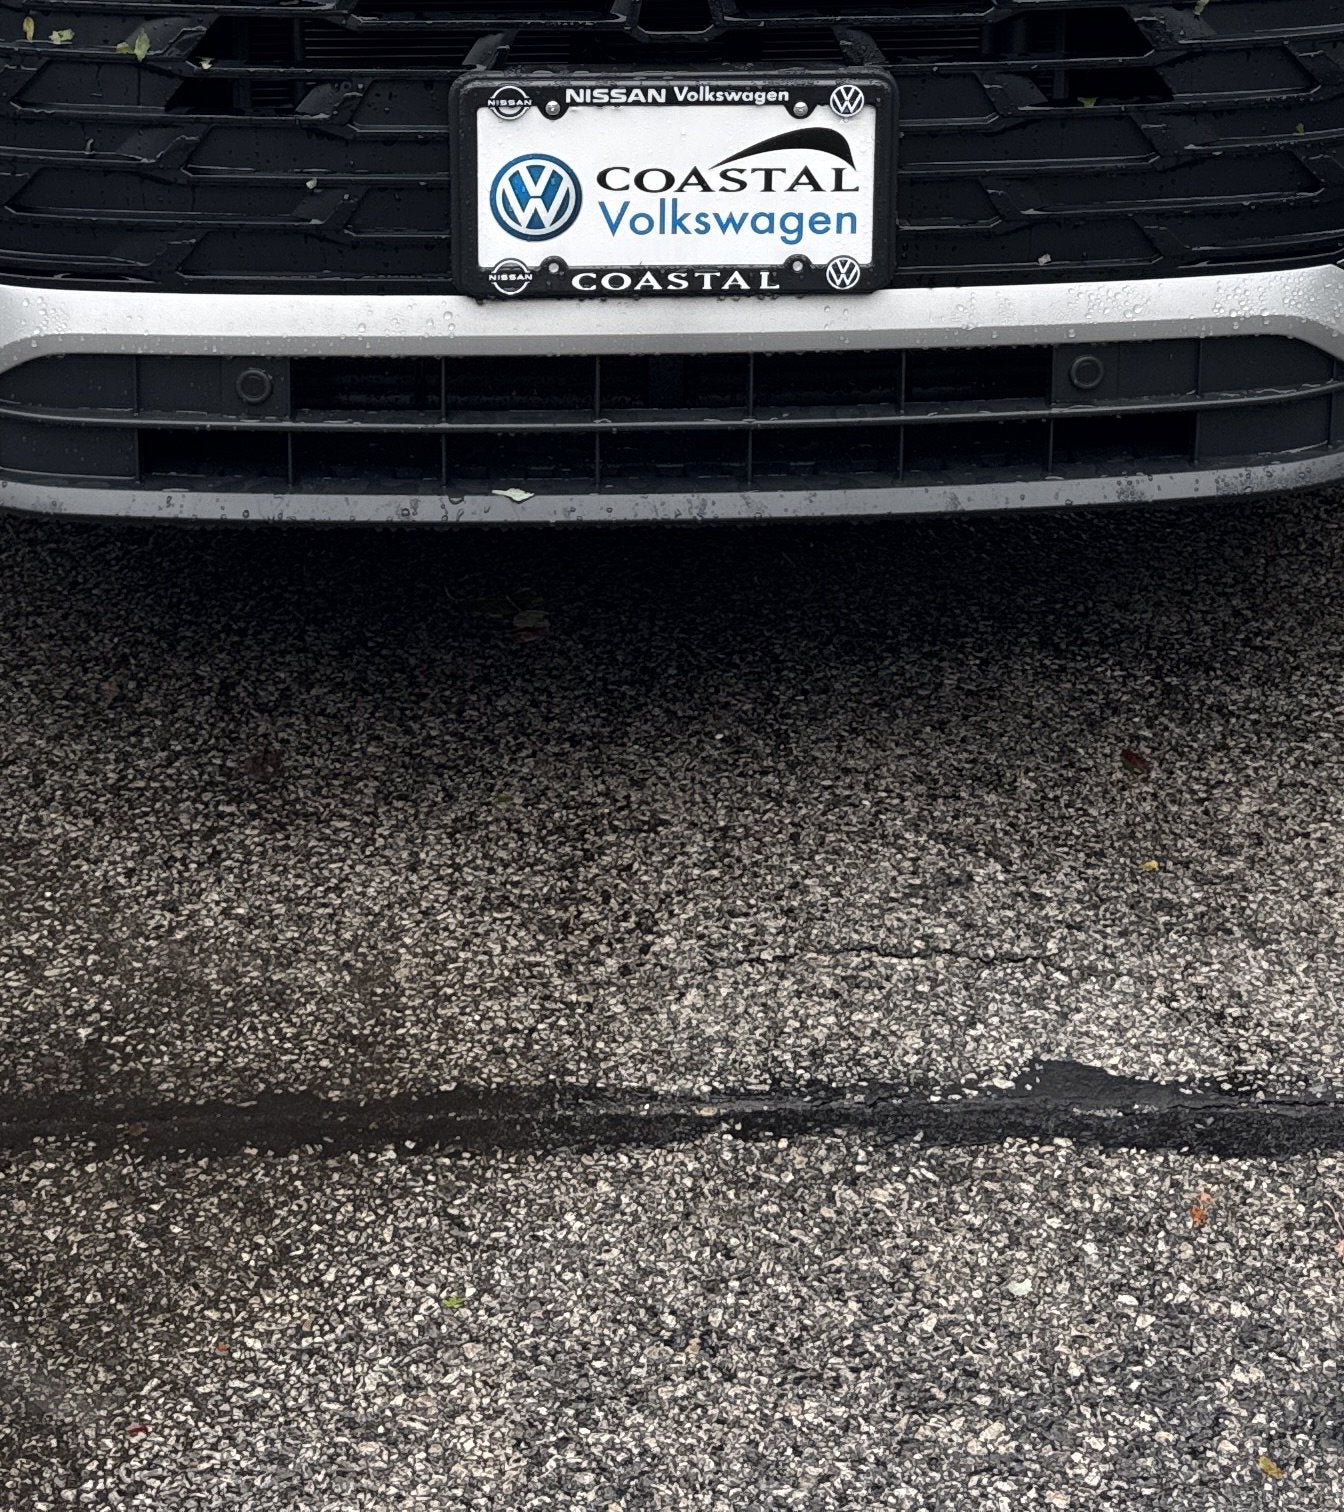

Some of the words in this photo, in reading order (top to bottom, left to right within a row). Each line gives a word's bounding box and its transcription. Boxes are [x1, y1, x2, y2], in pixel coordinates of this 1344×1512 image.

[488, 98, 533, 108] NISSAN
[565, 88, 666, 103] NISSAN
[673, 86, 790, 104] Volkswagen
[596, 166, 860, 193] COASTAL
[598, 198, 857, 245] Volkswagen
[488, 272, 533, 281] NISSAN
[572, 271, 780, 290] COASTAL
